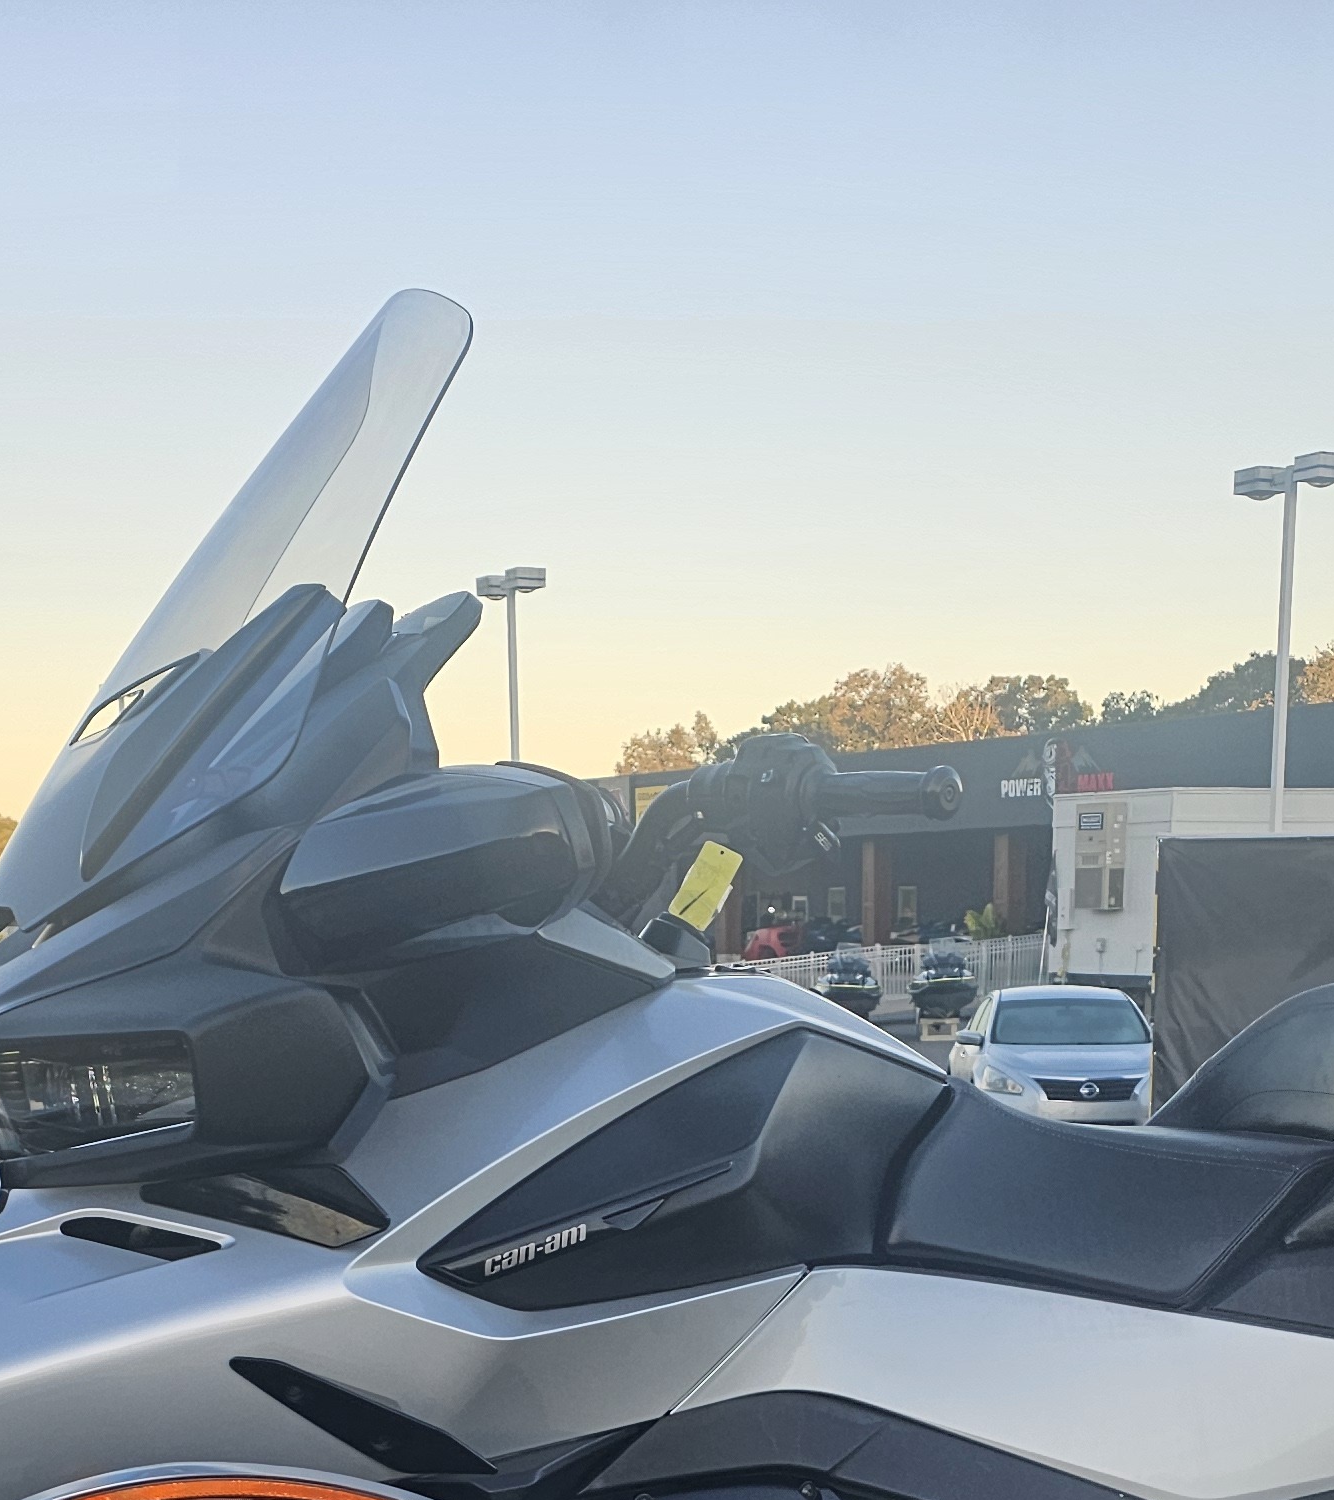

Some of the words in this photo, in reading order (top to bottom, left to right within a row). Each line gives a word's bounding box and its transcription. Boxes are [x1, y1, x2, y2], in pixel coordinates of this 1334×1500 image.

[1000, 778, 1042, 798] POWER
[1076, 772, 1115, 792] MAXX
[484, 1223, 587, 1277] can-am
